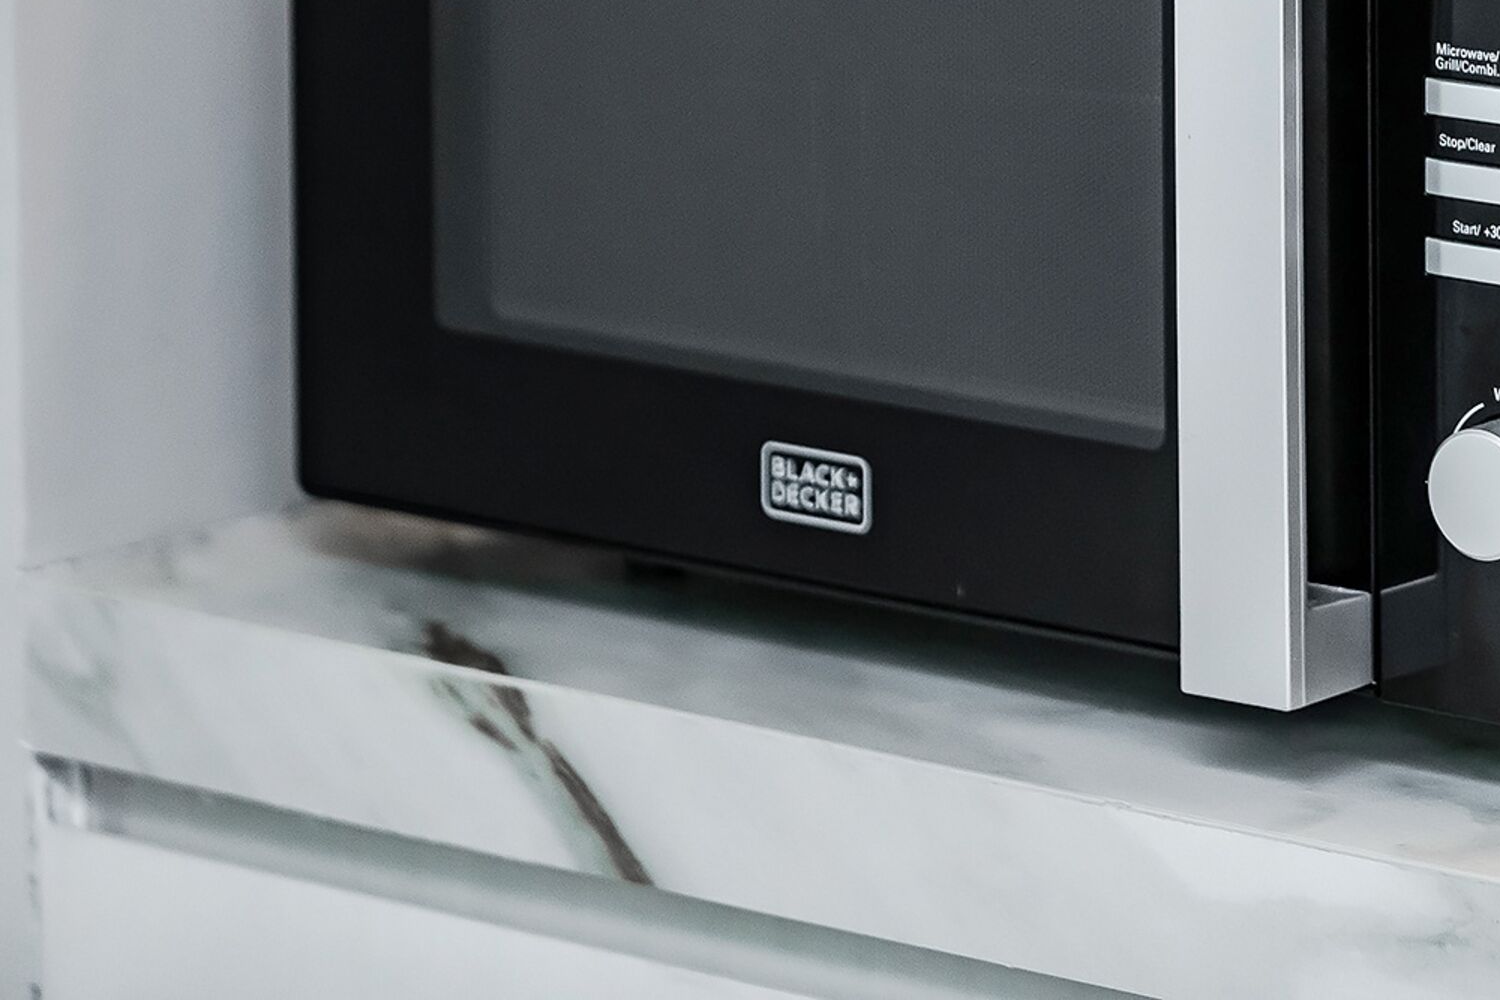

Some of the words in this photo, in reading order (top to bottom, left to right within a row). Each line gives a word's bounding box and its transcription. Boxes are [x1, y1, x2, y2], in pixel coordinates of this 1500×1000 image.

[1435, 42, 1500, 63] Microwave/
[1435, 57, 1500, 78] Grill/Combi.
[1439, 133, 1497, 153] Stop/Clear
[1452, 220, 1481, 238] Start/
[771, 455, 859, 490] BLACK+
[771, 480, 861, 518] DECKER
